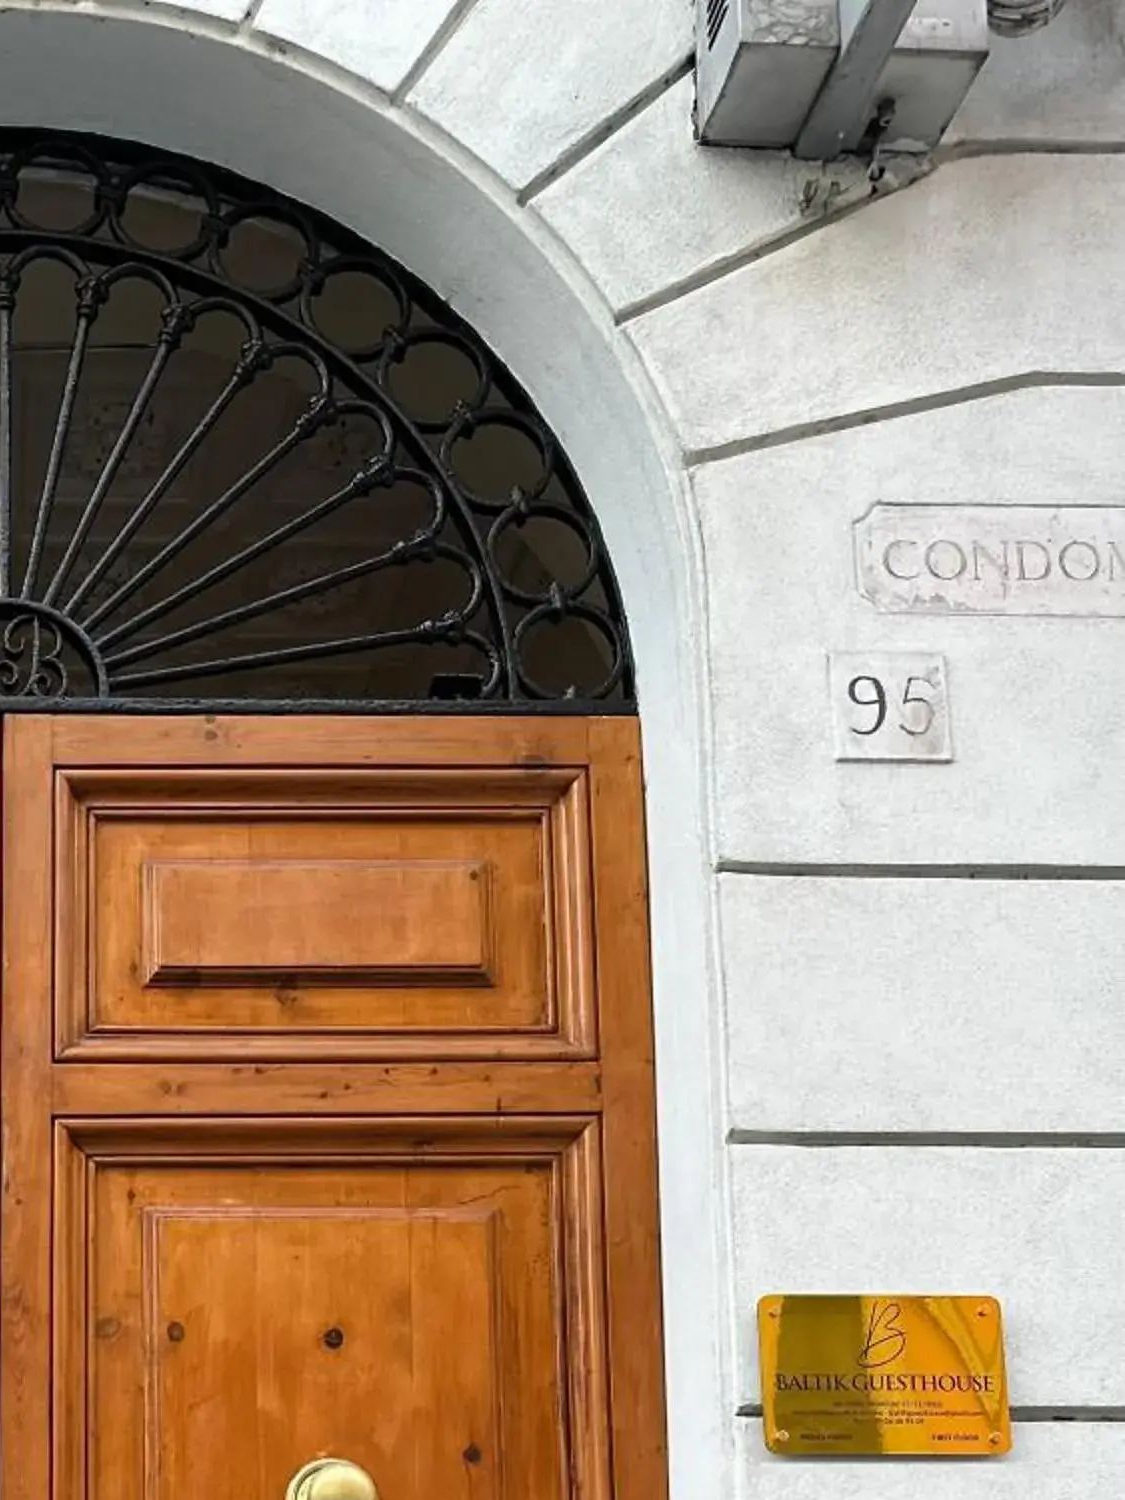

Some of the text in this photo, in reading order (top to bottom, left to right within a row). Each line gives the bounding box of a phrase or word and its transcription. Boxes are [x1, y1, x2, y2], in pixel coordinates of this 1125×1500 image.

[847, 675, 941, 736] 95
[857, 1302, 907, 1369] B
[776, 1372, 996, 1394] BALTIK GUESTHOUSE
